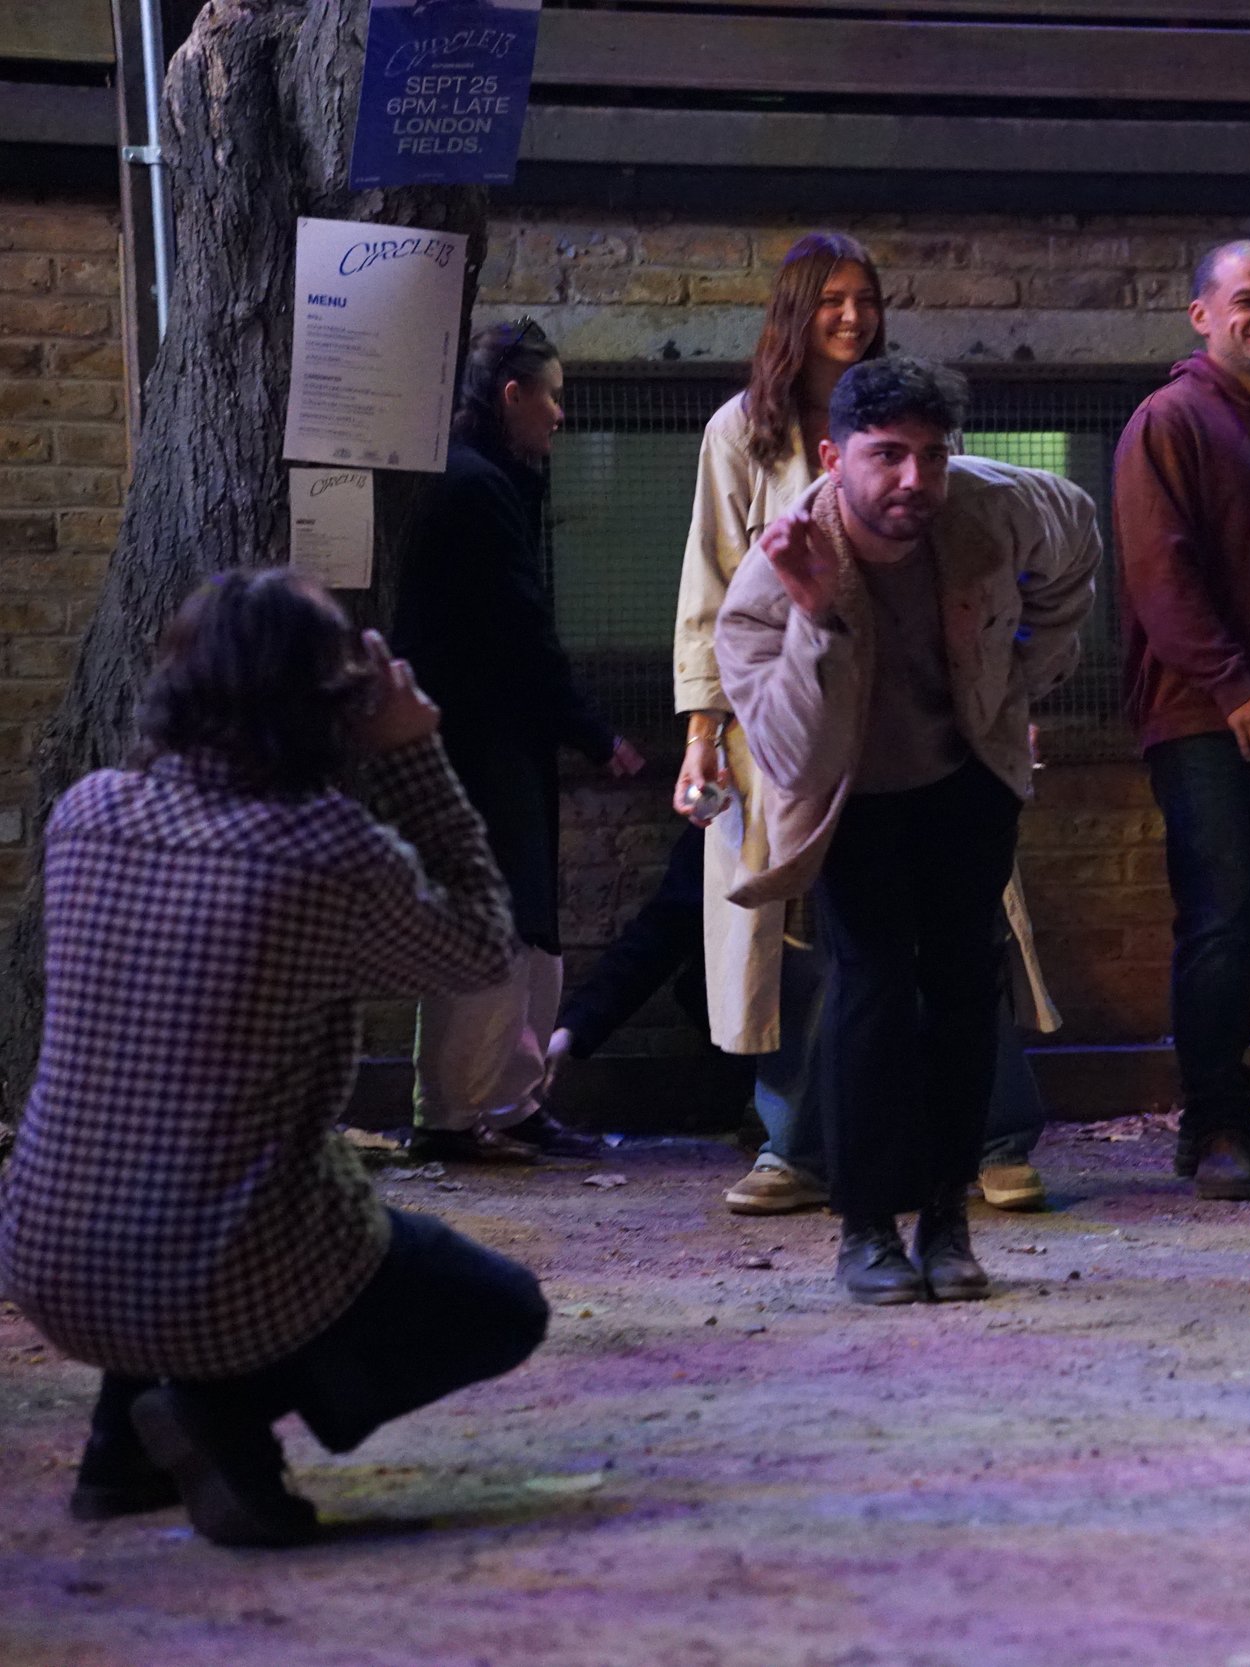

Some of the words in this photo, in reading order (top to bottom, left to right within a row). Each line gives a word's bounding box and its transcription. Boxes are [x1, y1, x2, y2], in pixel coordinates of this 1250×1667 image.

[405, 76, 467, 95] SEPT
[469, 75, 498, 94] 25
[386, 97, 436, 116] 6PM
[452, 96, 511, 115] LATE
[393, 117, 492, 135] LONDON
[397, 137, 483, 155] FIELDS.
[307, 293, 348, 309] MENU
